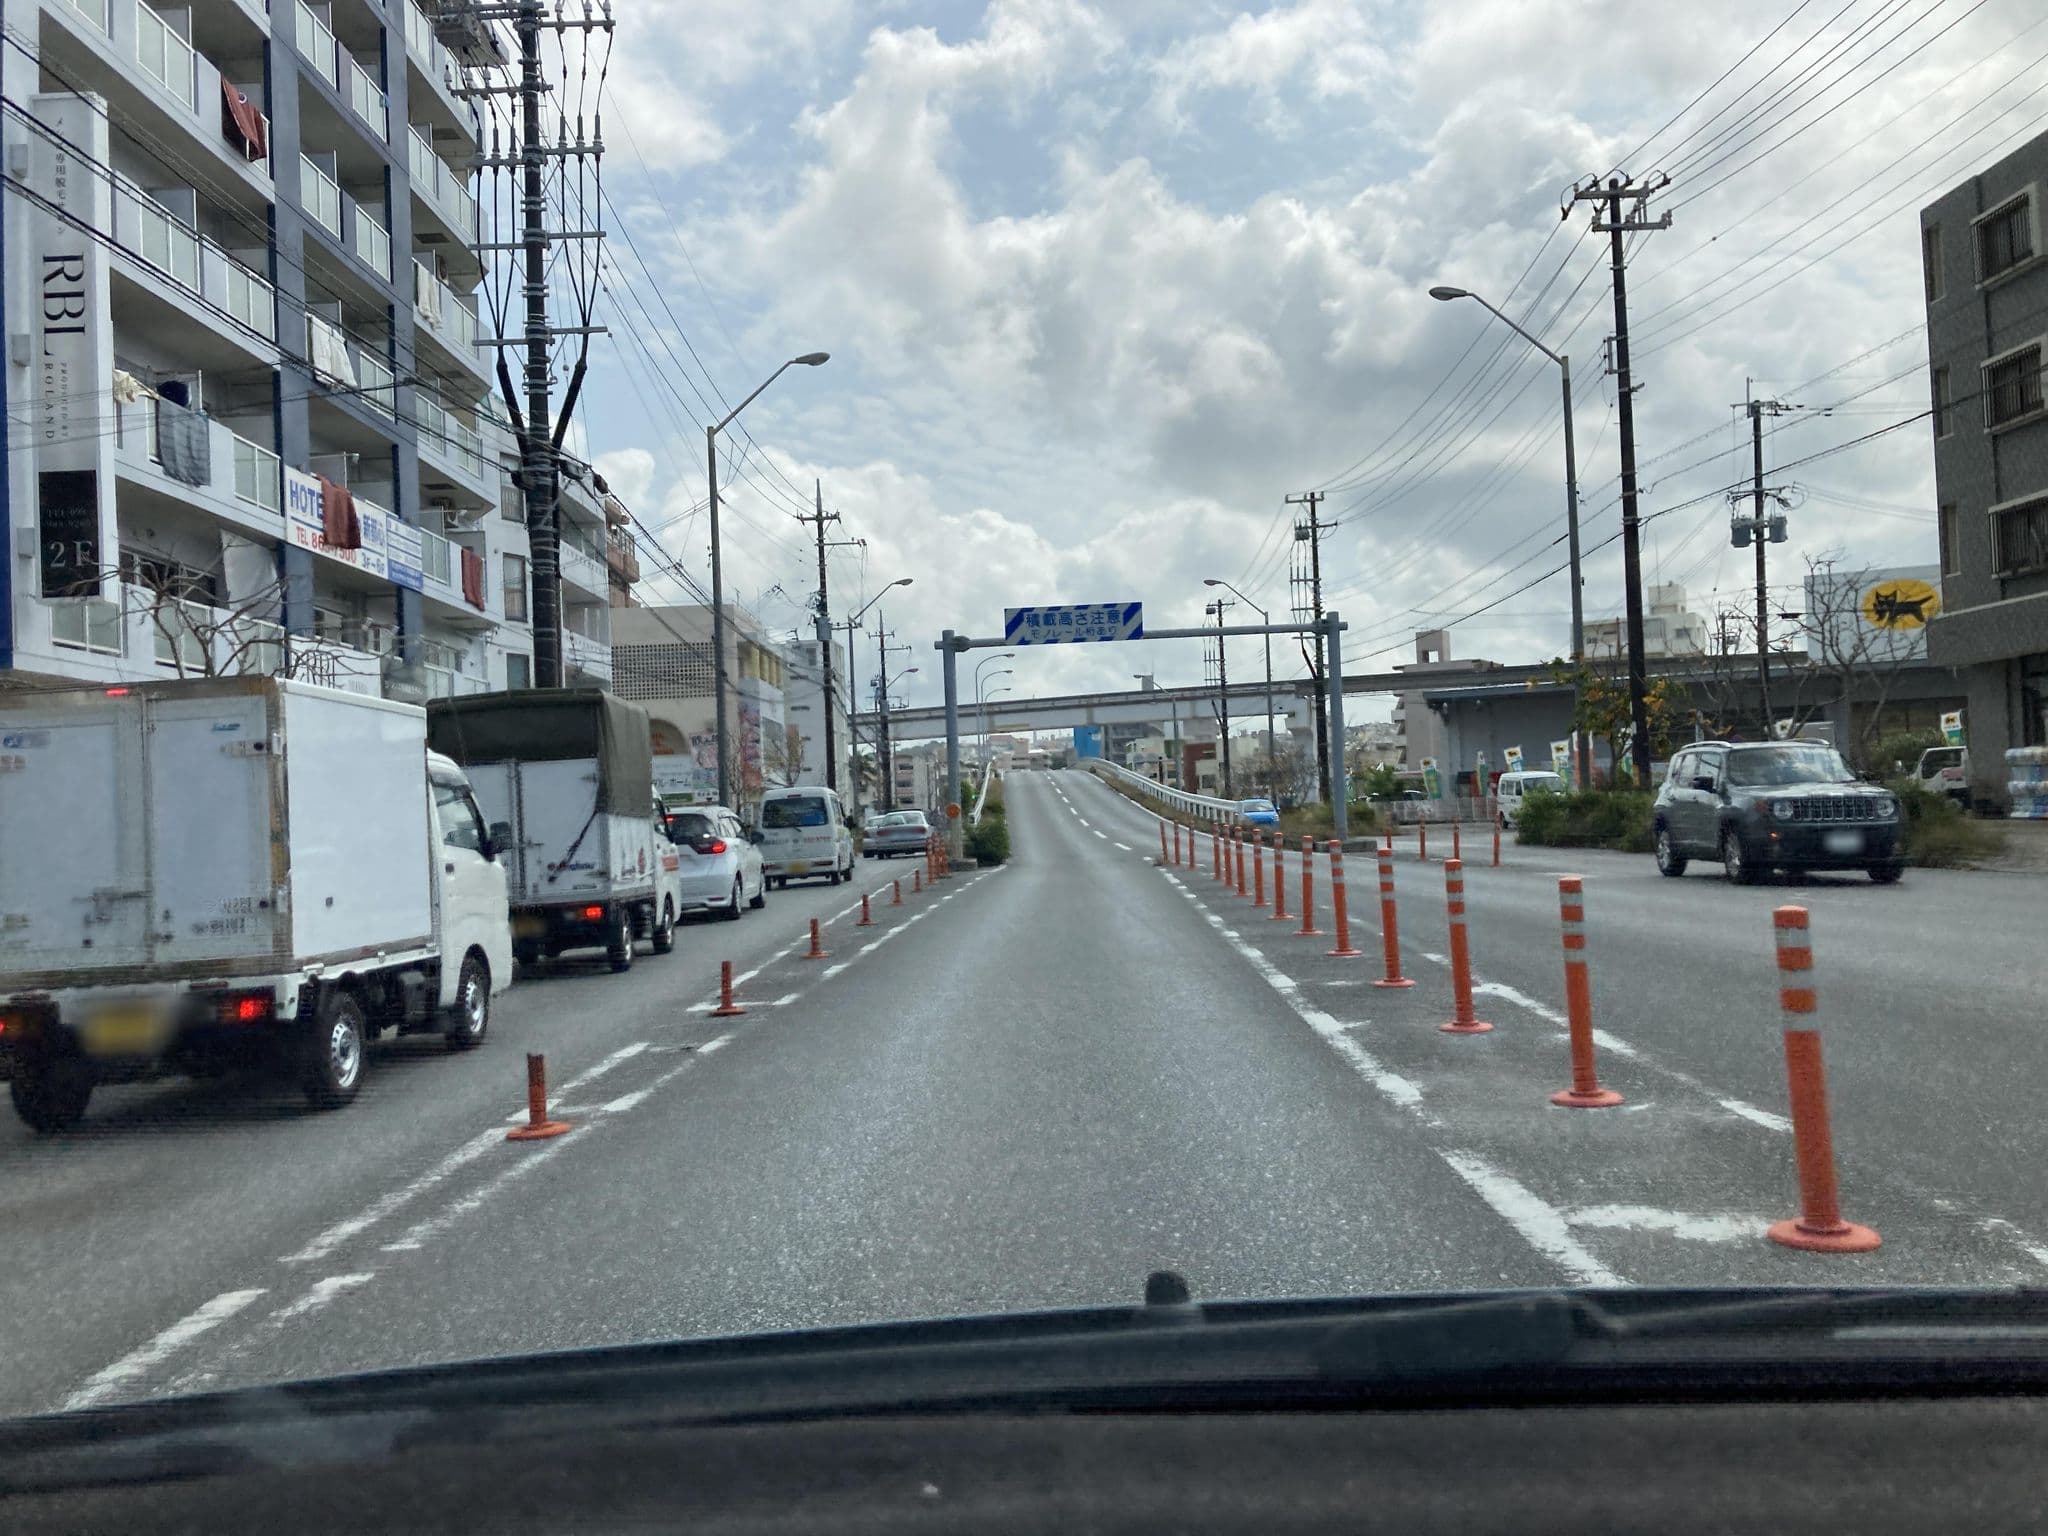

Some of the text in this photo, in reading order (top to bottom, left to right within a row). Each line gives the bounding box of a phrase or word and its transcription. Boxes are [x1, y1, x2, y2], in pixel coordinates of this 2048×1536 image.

[42, 254, 86, 357] RBL
[44, 362, 55, 439] ROLAND
[289, 479, 325, 521] HOTE
[296, 526, 309, 547] TEL
